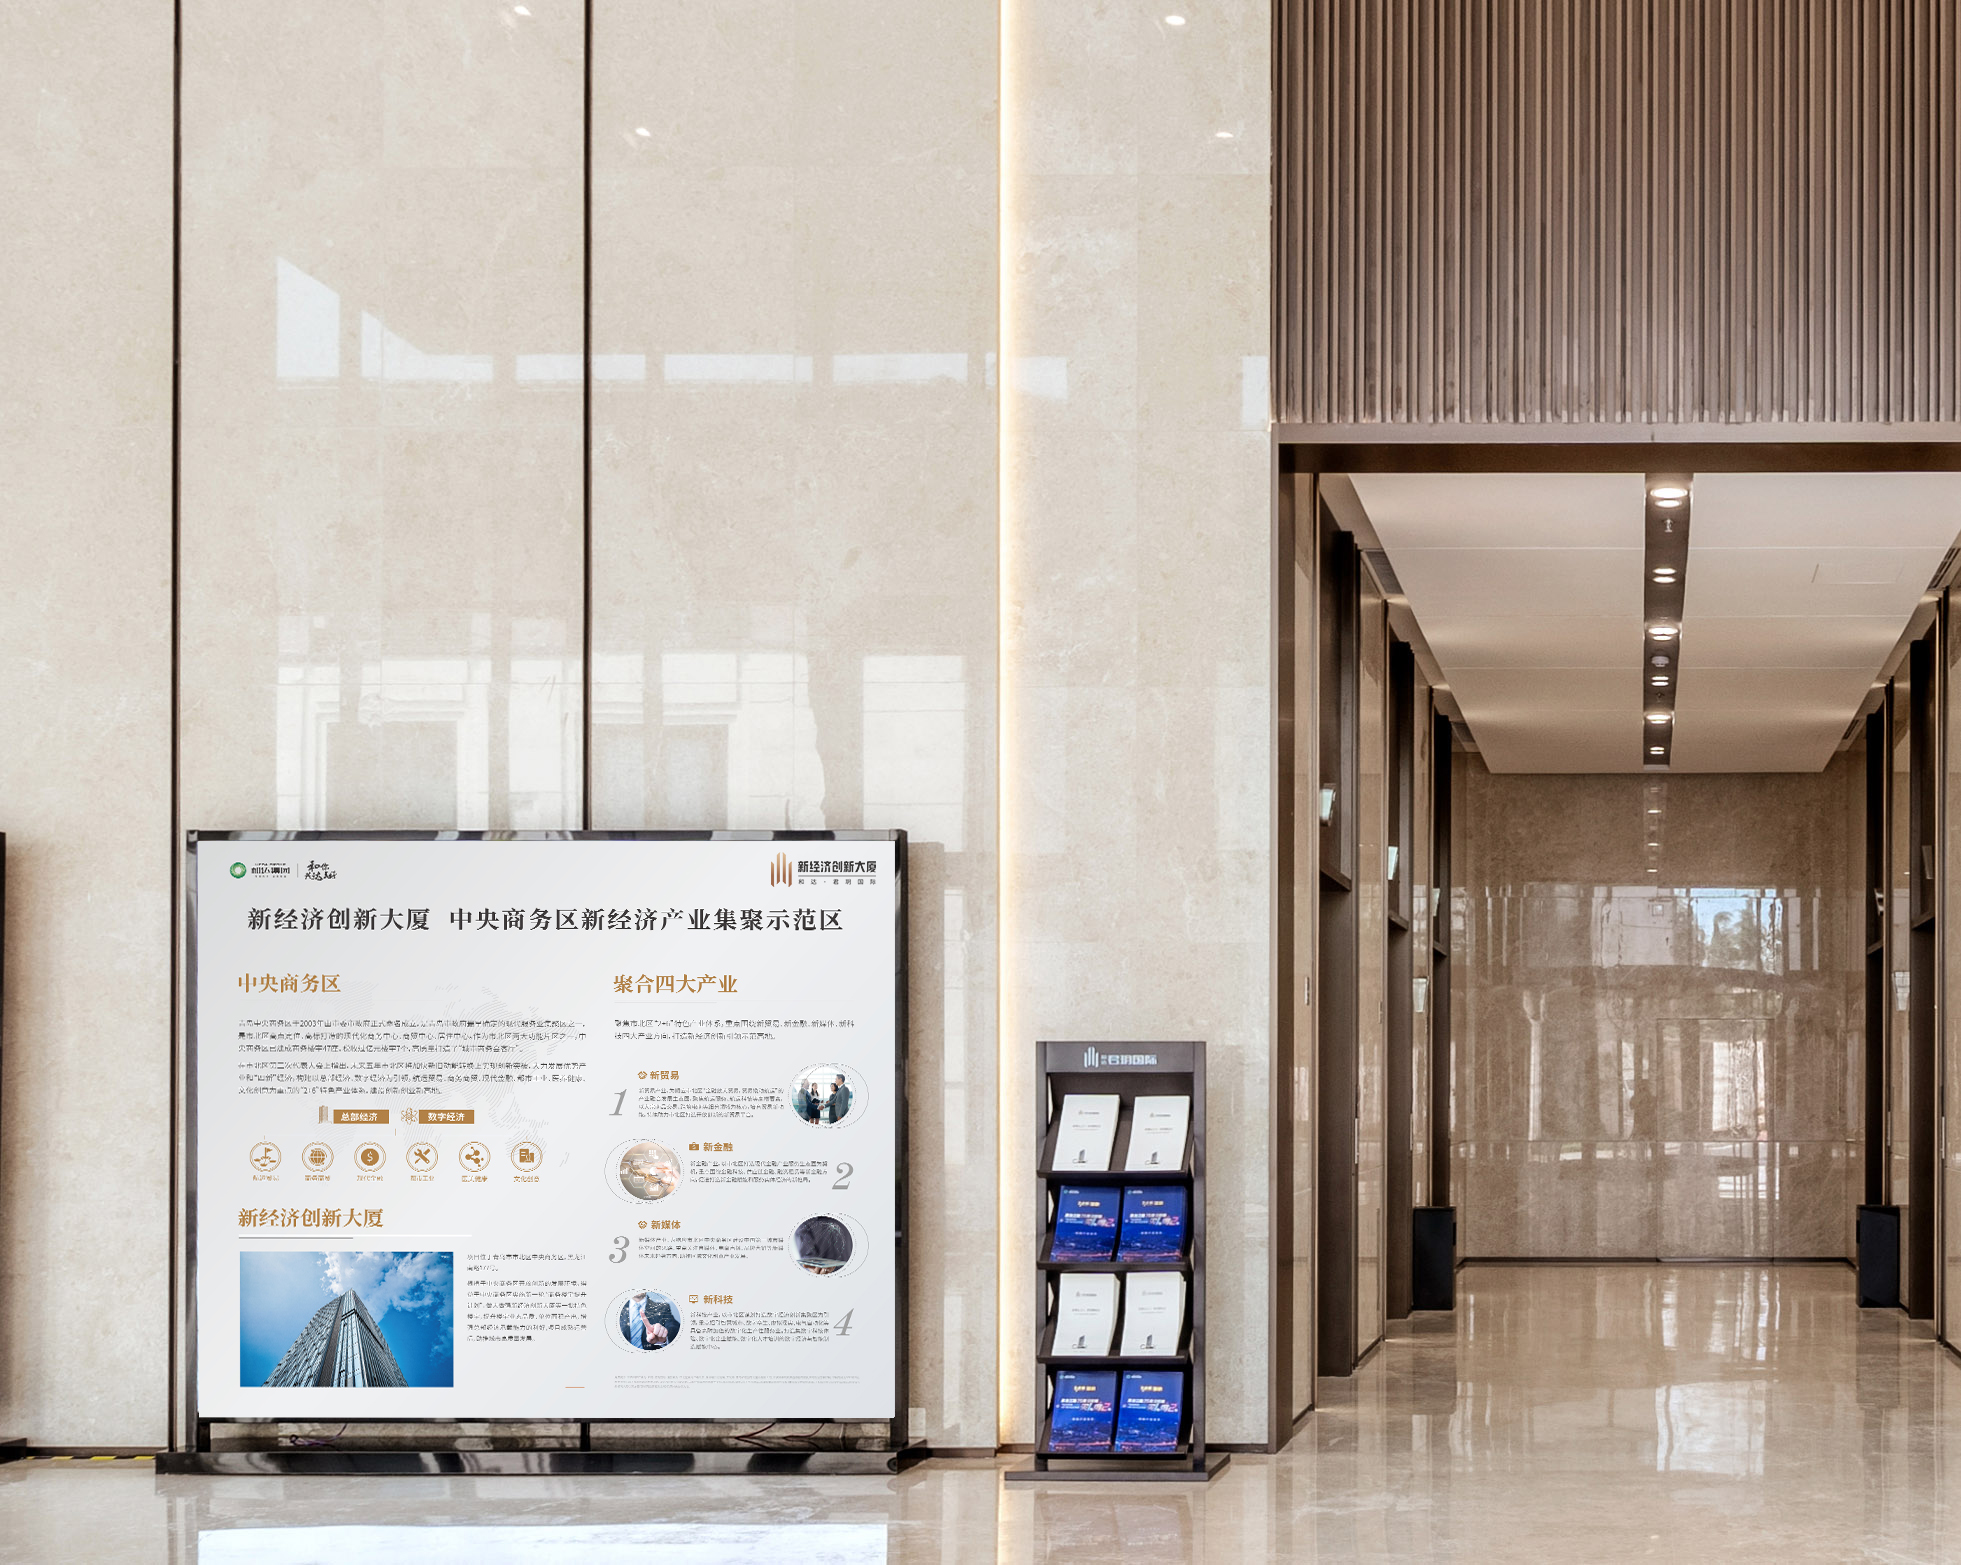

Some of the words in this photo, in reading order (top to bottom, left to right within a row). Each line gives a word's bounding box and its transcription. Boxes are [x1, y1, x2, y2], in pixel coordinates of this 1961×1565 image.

[797, 860, 877, 873] 新经济创新大厦
[247, 906, 431, 932] 新经济创新大厦
[449, 907, 844, 932] 中央商务区新经济产业集聚示范区
[238, 972, 342, 994] 中央商务区
[612, 973, 739, 994] 聚合四大产业
[649, 1070, 680, 1081] 新贸易
[608, 1088, 628, 1116] 1
[340, 1111, 378, 1123] 总部经济
[427, 1111, 466, 1122] 数字经济
[702, 1141, 734, 1152] 新金融
[831, 1161, 854, 1191] 2
[237, 1207, 384, 1229] 新经济创新大厦
[650, 1219, 682, 1230] 新媒体
[608, 1235, 630, 1264] 3
[702, 1294, 734, 1305] 新科技
[832, 1307, 855, 1337] 4
